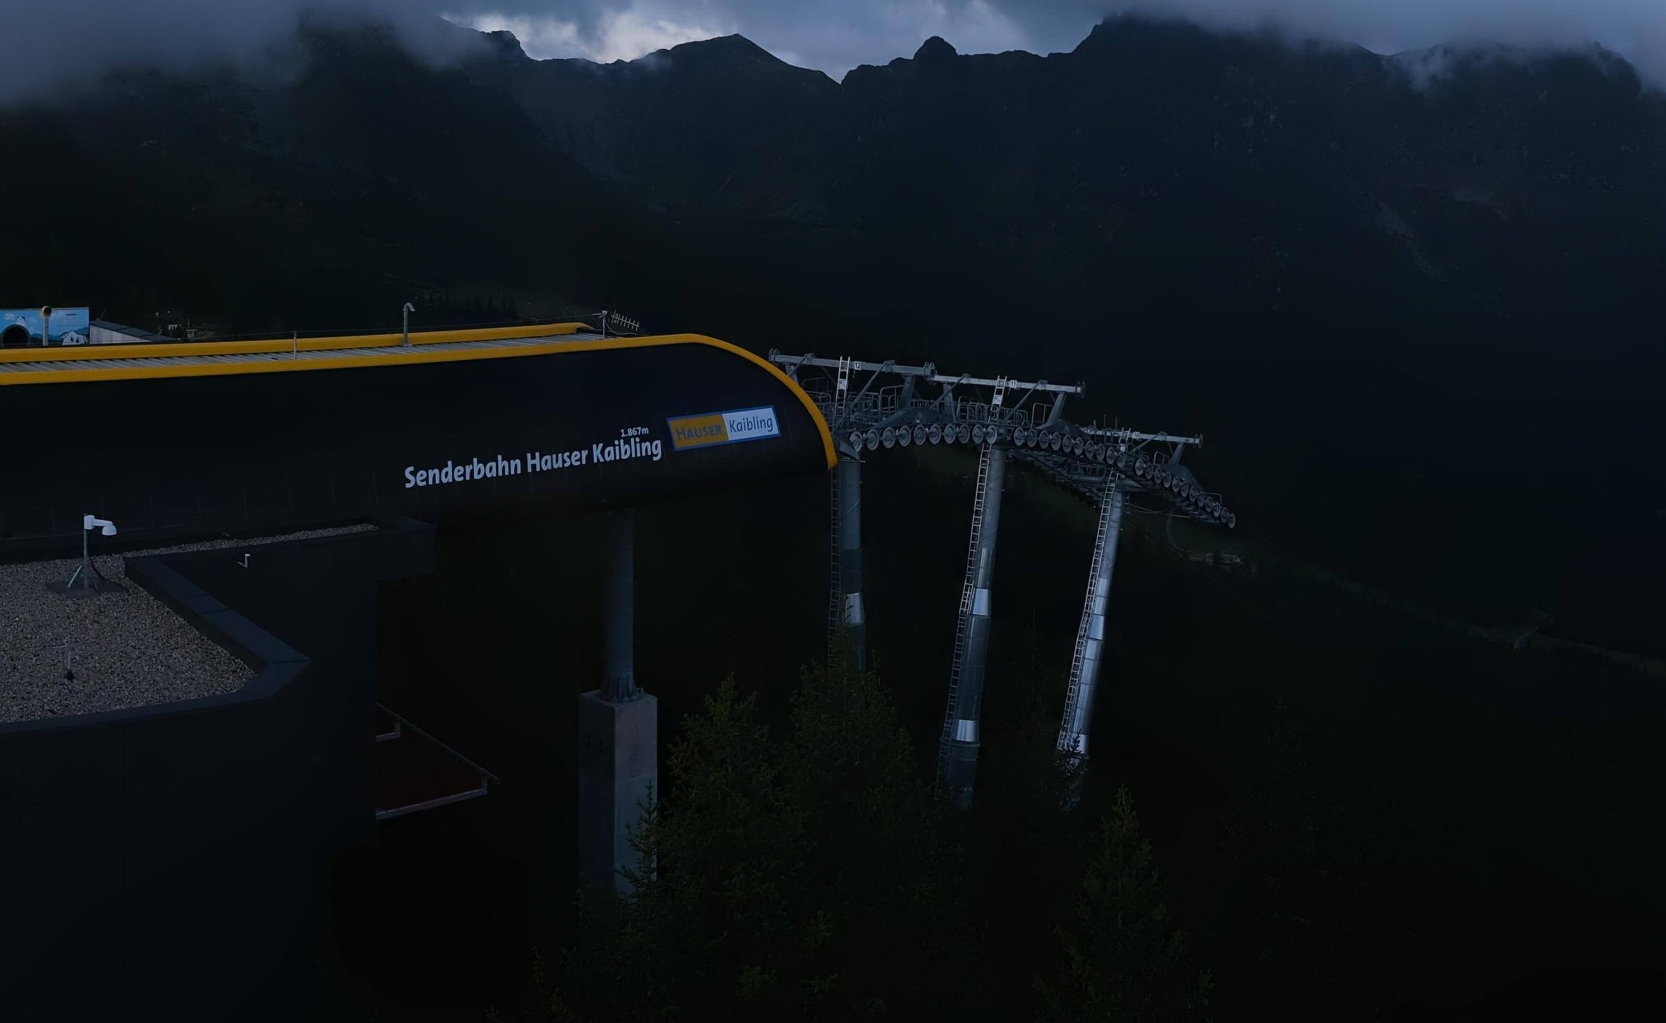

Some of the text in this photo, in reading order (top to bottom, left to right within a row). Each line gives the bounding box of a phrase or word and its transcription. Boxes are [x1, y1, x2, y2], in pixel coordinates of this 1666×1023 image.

[620, 426, 649, 438] 1.867m
[676, 415, 773, 441] HAUSER Kaibling
[404, 436, 662, 489] Senderbahn Hauser Kaibling
